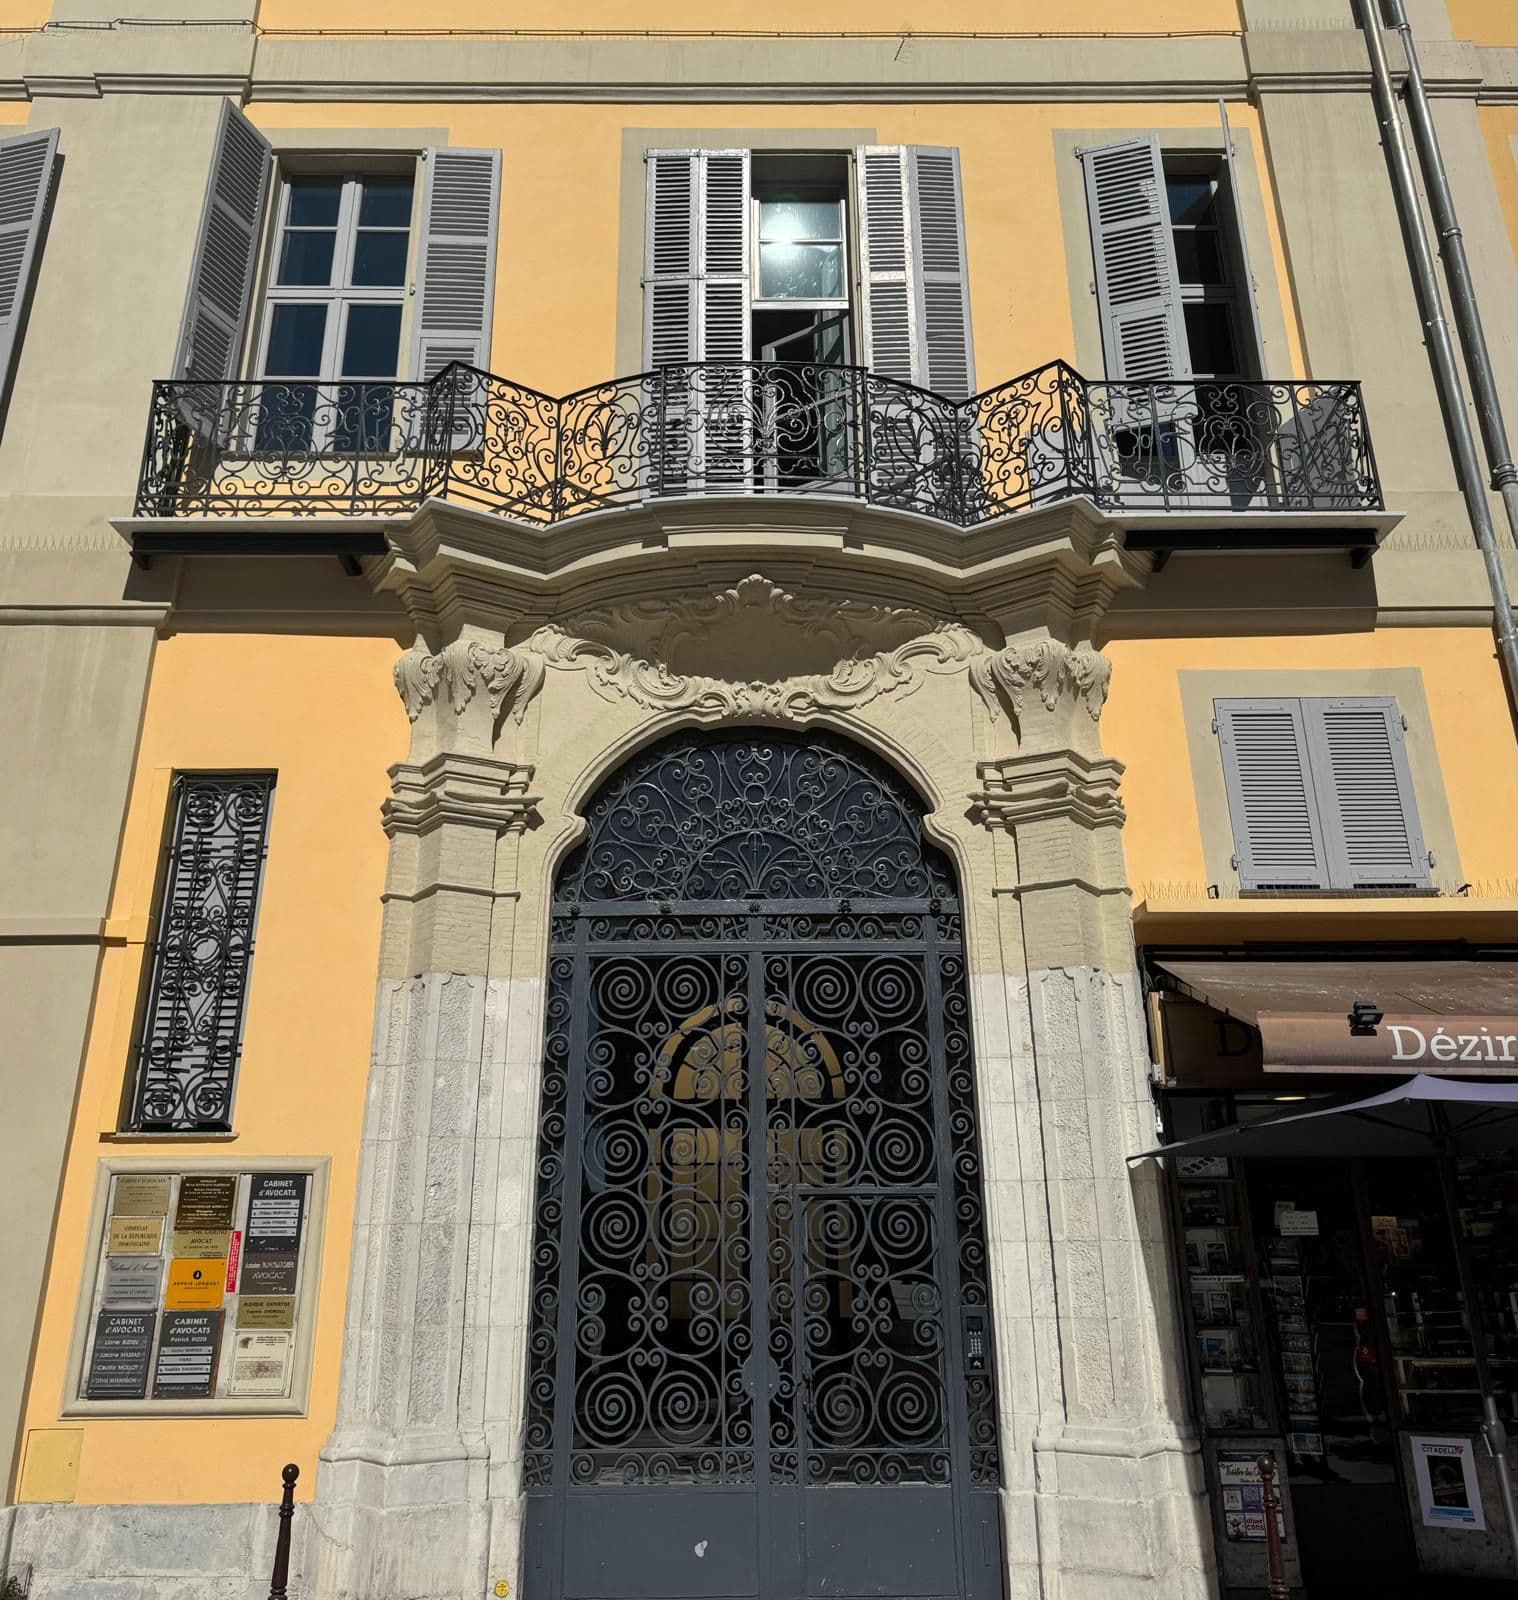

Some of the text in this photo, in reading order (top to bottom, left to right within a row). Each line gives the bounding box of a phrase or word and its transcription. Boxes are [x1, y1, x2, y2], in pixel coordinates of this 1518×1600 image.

[263, 1180, 294, 1188] CABINET
[258, 1189, 297, 1197] d'AVOCATS
[252, 1271, 287, 1280] AVOCAT
[110, 1318, 143, 1326] CABINET
[105, 1326, 145, 1334] d'AVOCATS
[169, 1327, 211, 1335] d'AVOCATS
